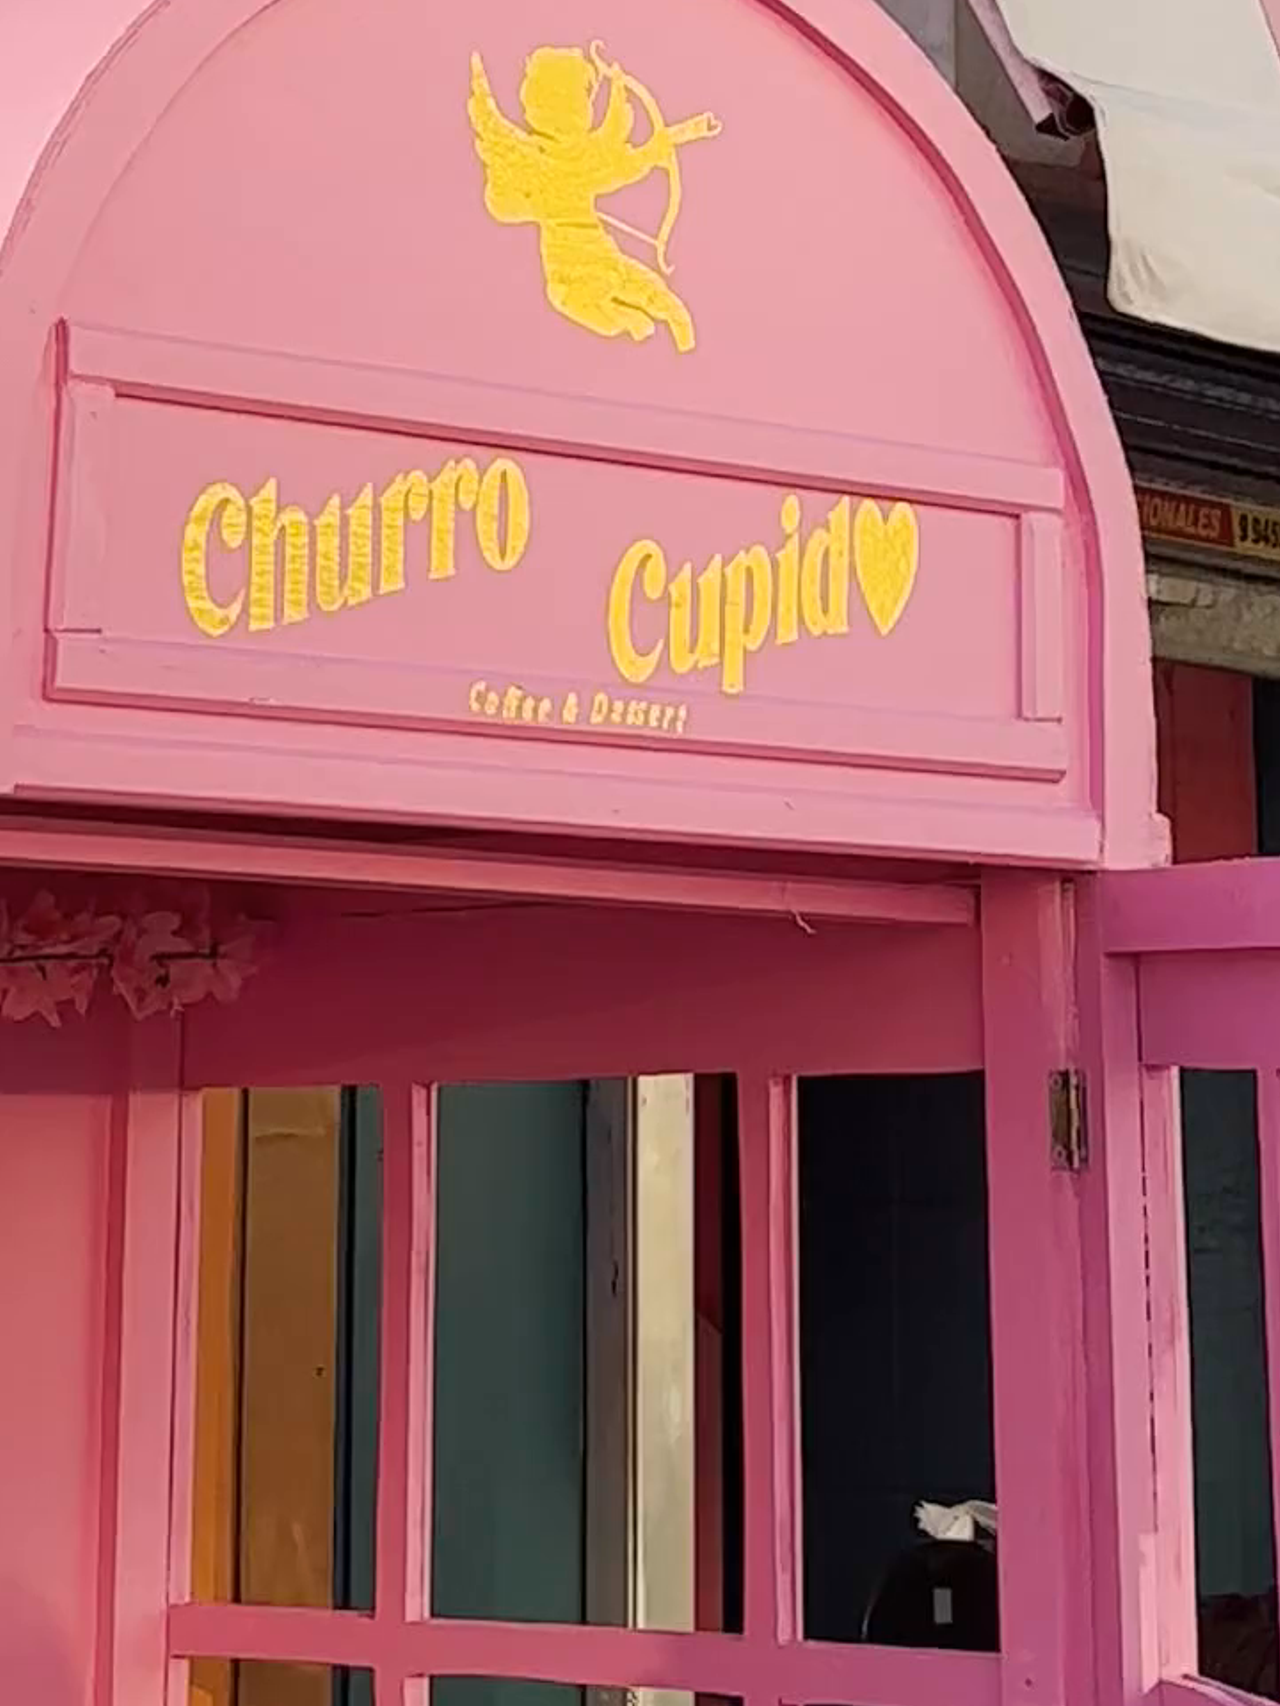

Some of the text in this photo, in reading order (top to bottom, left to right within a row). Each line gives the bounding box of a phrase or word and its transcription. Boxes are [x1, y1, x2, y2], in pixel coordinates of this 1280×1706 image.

[1135, 493, 1223, 540] IONALES
[181, 457, 532, 638] Churro
[468, 680, 553, 726] Coffee
